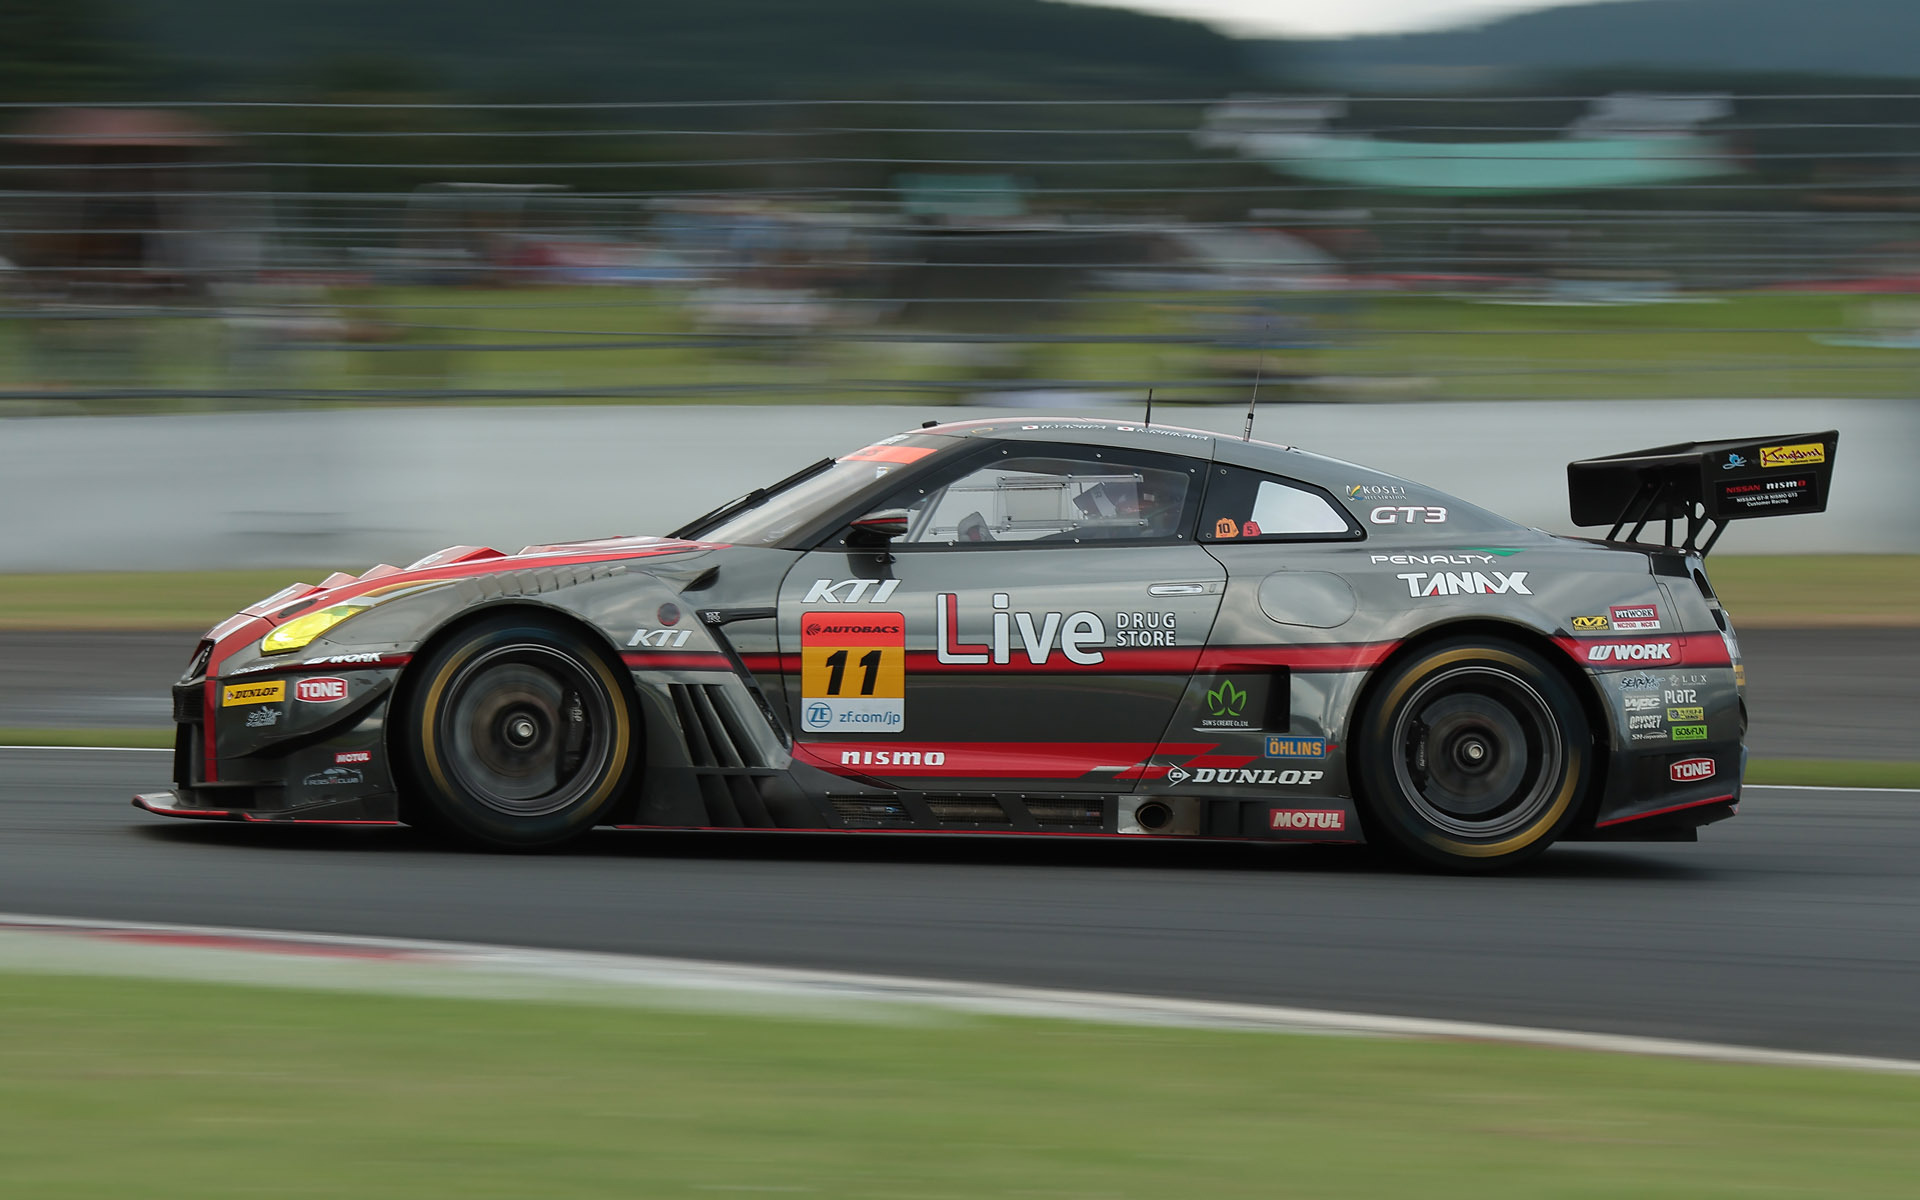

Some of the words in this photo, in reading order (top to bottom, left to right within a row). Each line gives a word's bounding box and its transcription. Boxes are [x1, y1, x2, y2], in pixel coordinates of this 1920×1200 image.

[1362, 485, 1406, 494] KOSEI
[1726, 484, 1760, 494] NISSAN
[1766, 480, 1807, 490] nismo
[1370, 505, 1448, 524] GT3
[1218, 523, 1230, 534] 10
[1247, 526, 1253, 535] 5
[1370, 554, 1494, 565] PENALTY
[800, 578, 902, 604] KTI
[1396, 571, 1535, 598] TANAX
[936, 592, 1107, 665] Live
[1115, 612, 1177, 629] DRUG
[626, 628, 694, 648] KTI
[822, 626, 900, 634] AUTOBACS
[1115, 630, 1177, 647] STORE
[328, 652, 384, 664] WORK
[1613, 643, 1672, 660] WORK
[825, 650, 882, 696] 11
[1682, 675, 1707, 683] LUX
[234, 687, 279, 700] DUNLOP
[300, 682, 343, 698] TONE
[807, 706, 832, 724] ZF
[839, 711, 900, 725] zf.com/jp
[1269, 738, 1322, 756] ÖHLINS
[336, 752, 371, 763] MOTUL
[841, 751, 946, 766] nismo
[1192, 768, 1324, 785] DUNLOP
[1674, 761, 1712, 778] TONE
[1272, 812, 1343, 828] MOTUL
